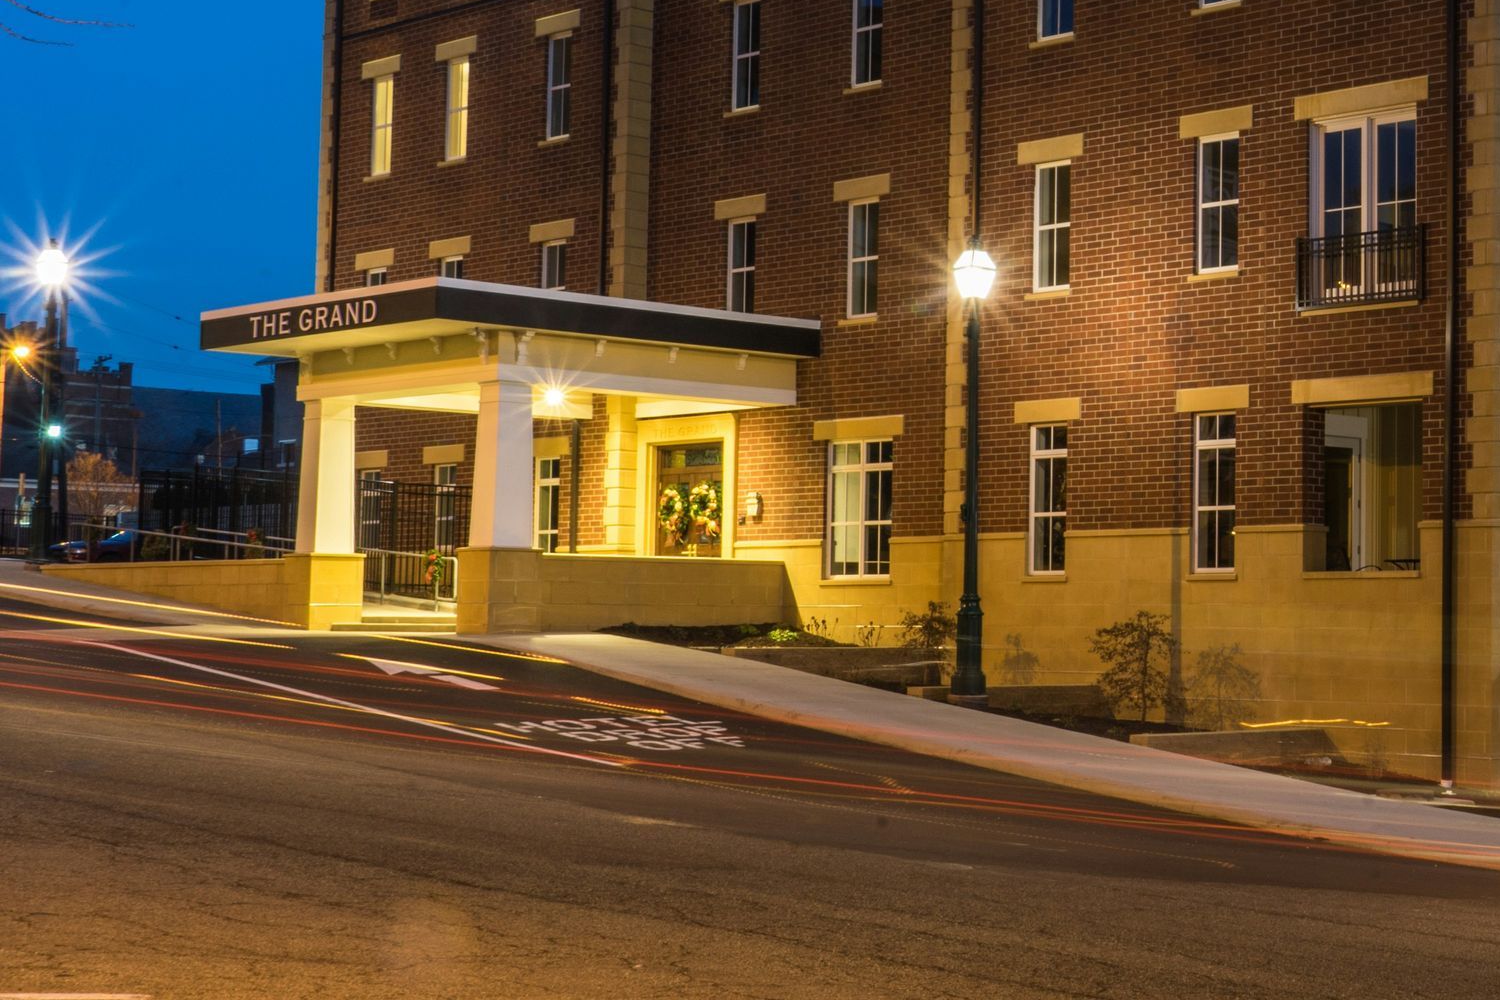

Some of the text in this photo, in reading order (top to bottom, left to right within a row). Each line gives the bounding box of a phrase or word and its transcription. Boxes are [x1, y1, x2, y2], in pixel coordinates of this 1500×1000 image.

[249, 300, 377, 338] THE GRAND
[655, 424, 674, 440] THE
[493, 715, 723, 732] HOTEL
[557, 725, 728, 742] DROP
[626, 736, 746, 750] OFF
